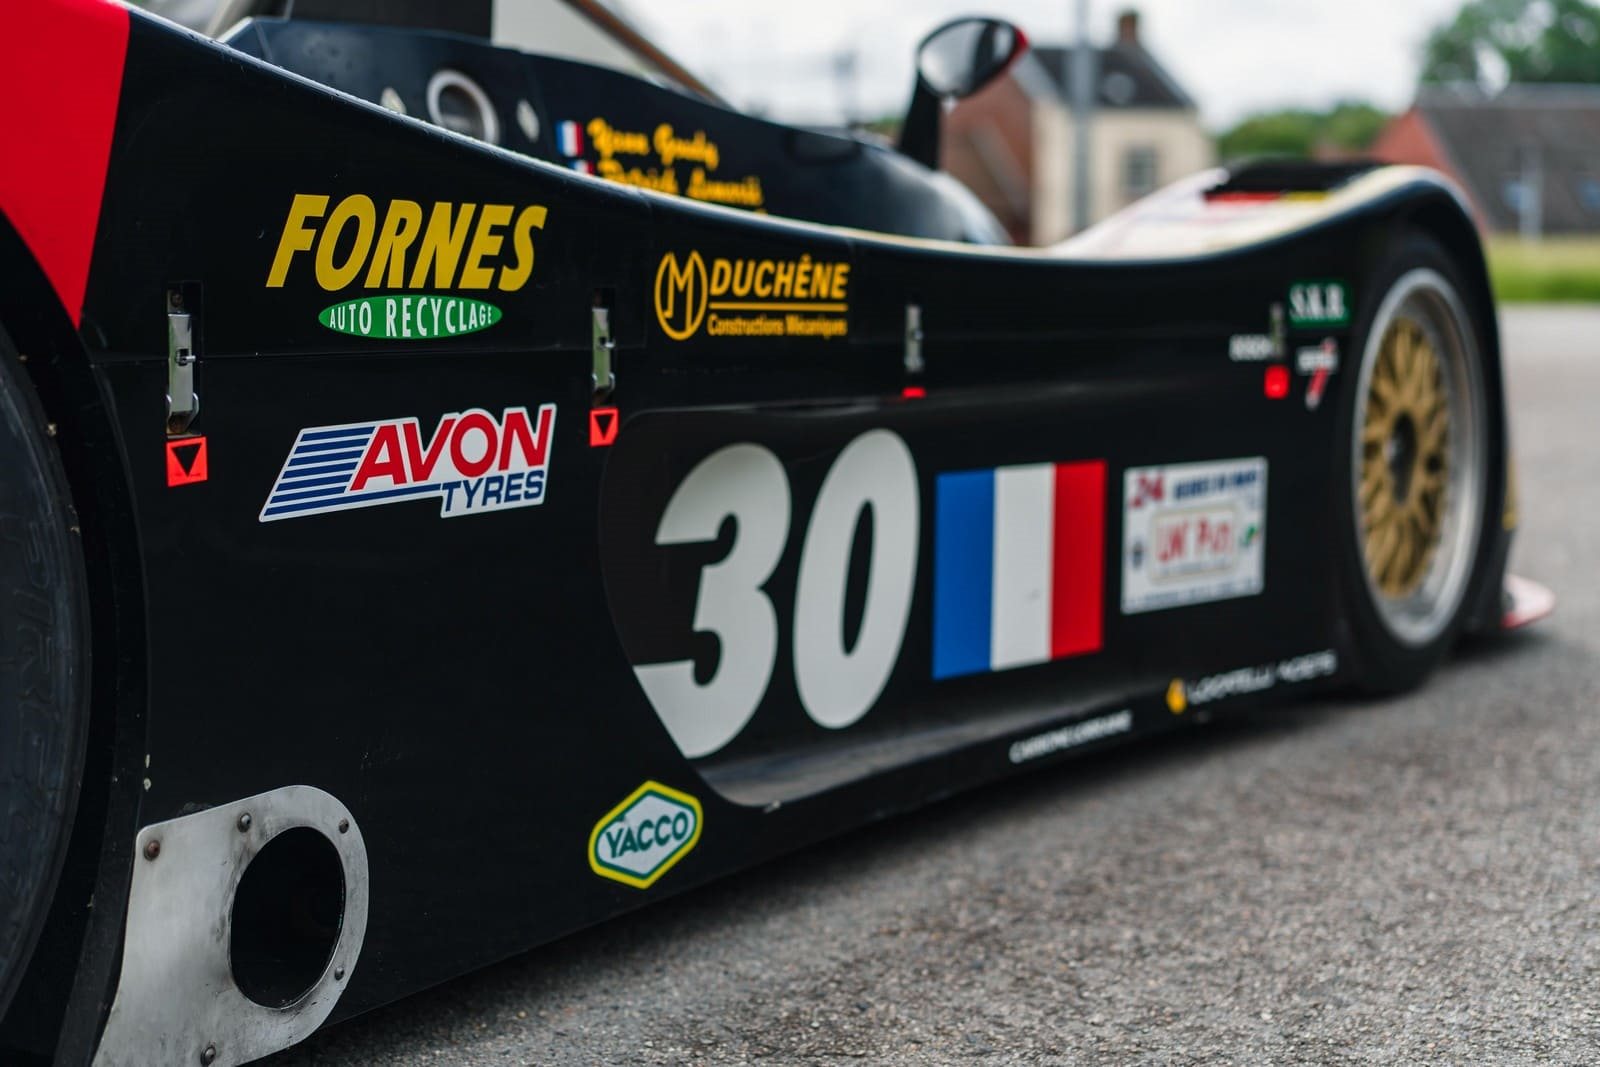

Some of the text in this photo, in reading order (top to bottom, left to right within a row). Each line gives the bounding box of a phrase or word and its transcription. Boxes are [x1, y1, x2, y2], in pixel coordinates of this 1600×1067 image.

[265, 193, 548, 292] FORNES
[709, 253, 850, 299] DUCHÊNE
[329, 297, 493, 337] AUTO RECYCLAGE
[707, 313, 784, 336] Constructions
[350, 408, 553, 491] AVON
[442, 470, 545, 512] TYRES
[633, 428, 921, 759] 30
[606, 811, 688, 859] YACCO
